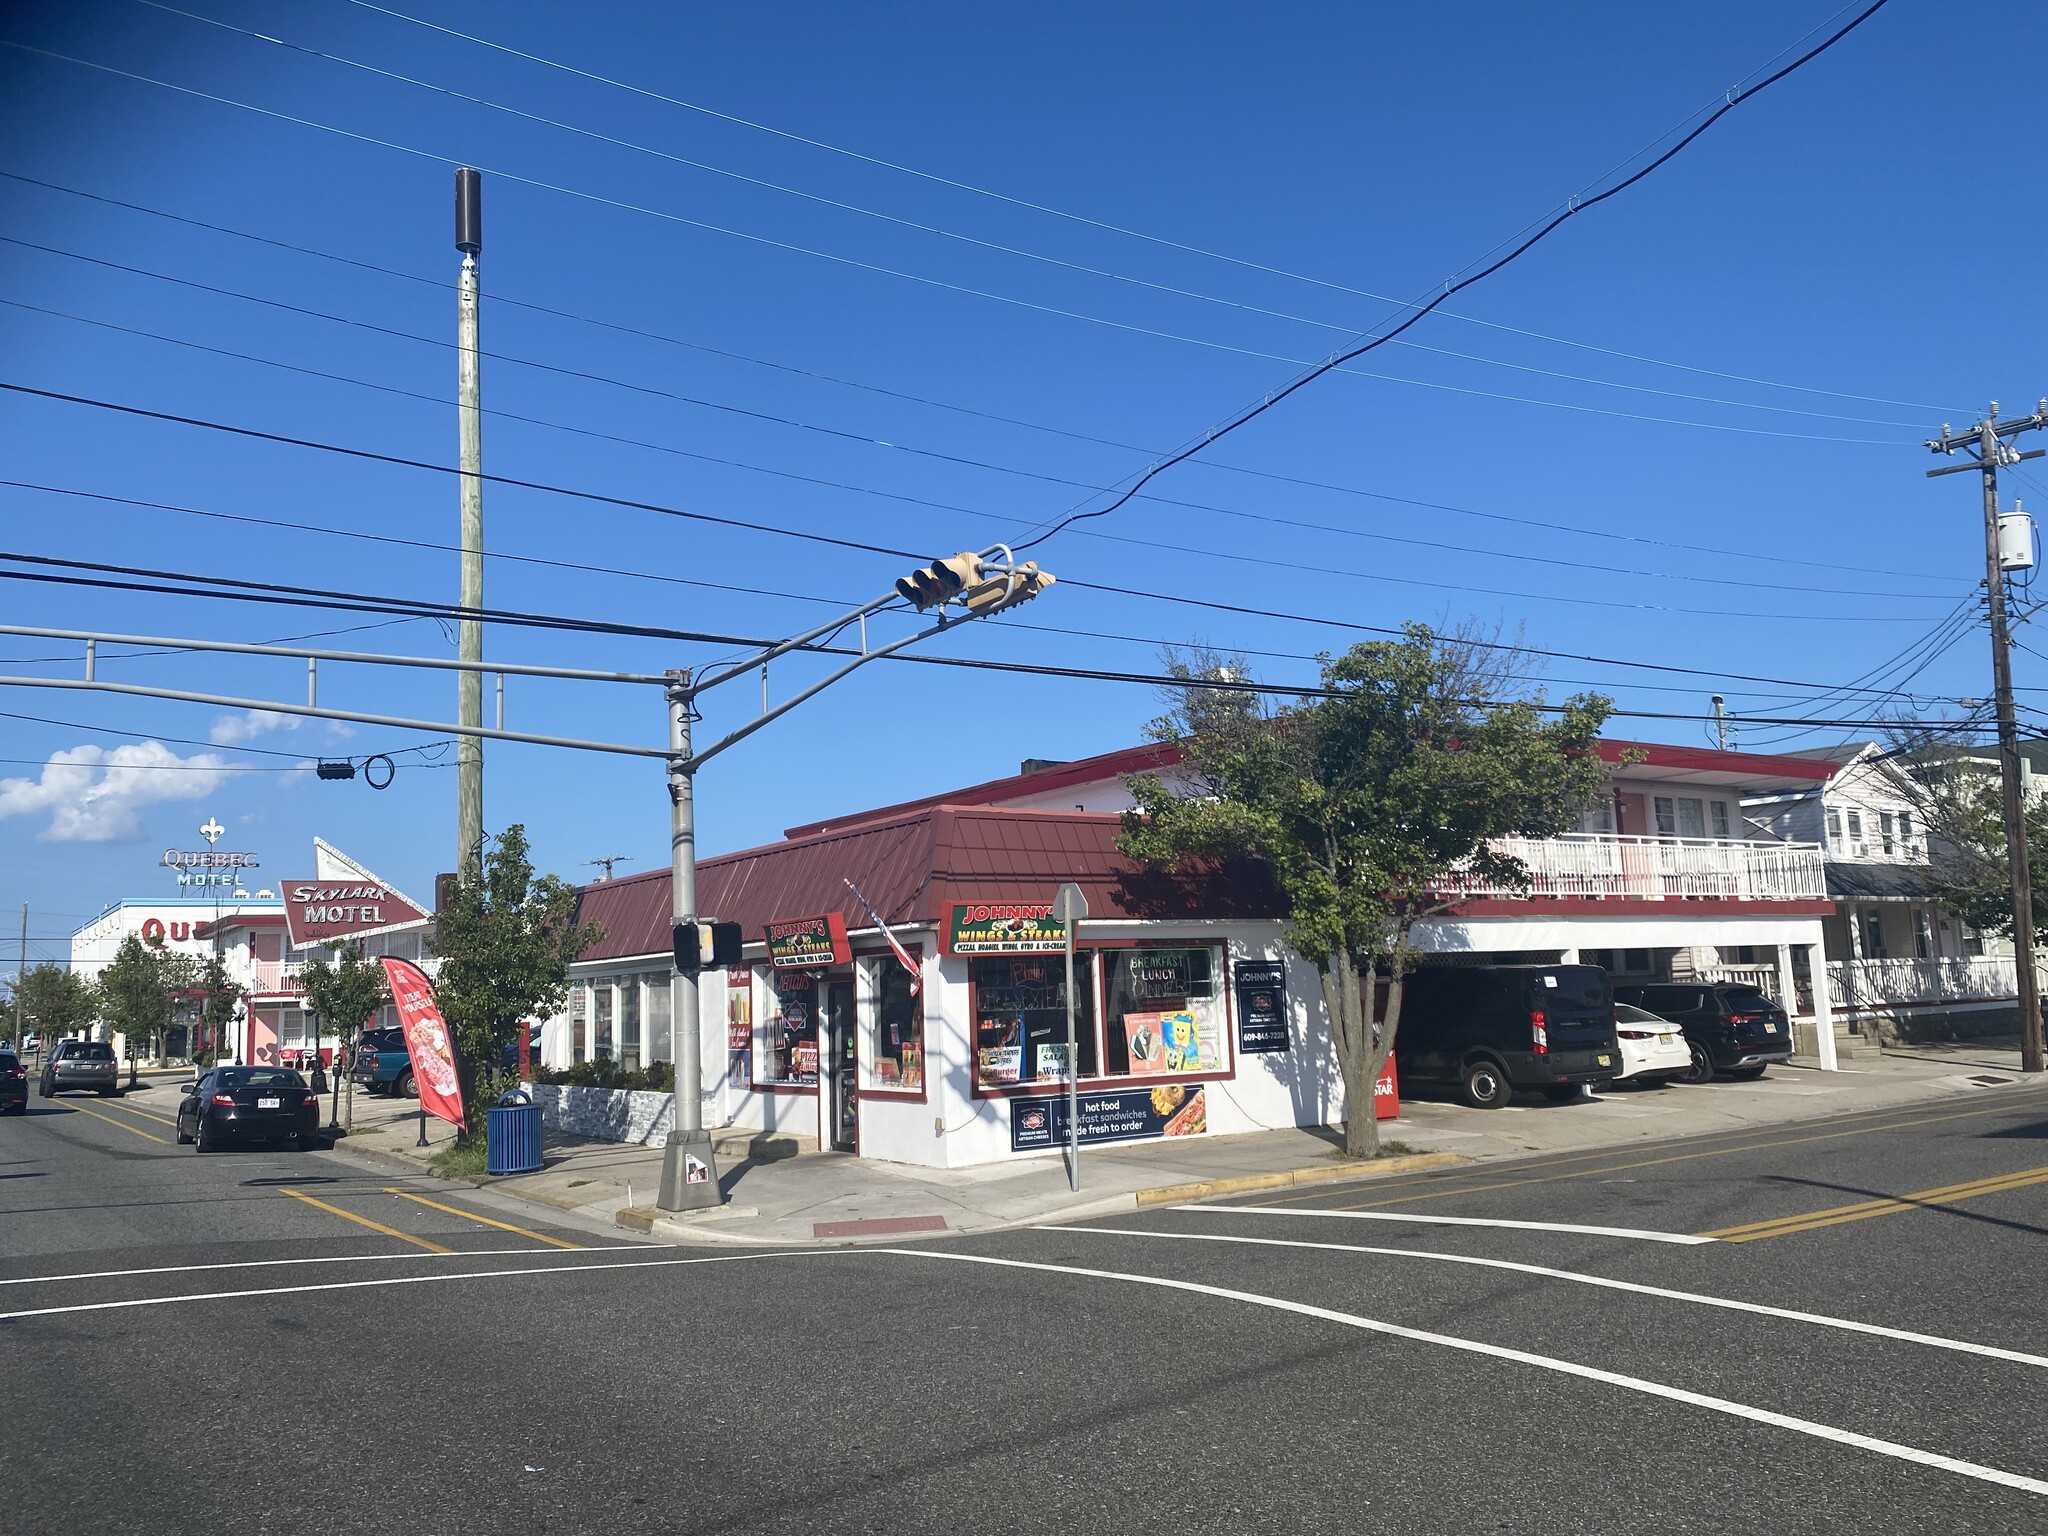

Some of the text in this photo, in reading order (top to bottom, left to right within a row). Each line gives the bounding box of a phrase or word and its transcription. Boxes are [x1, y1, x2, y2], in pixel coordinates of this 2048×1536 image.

[163, 848, 258, 870] QUEBEC
[177, 873, 244, 886] MOTEL
[290, 886, 389, 903] SKYLARK
[304, 905, 386, 923] MOTEL
[770, 920, 825, 942] JOHNNY'S
[958, 931, 1003, 941] WINGS
[1007, 930, 1016, 941] &
[772, 946, 795, 956] WINGS
[804, 942, 830, 953] STEAKS
[1131, 957, 1184, 968] BREAKFAST
[1141, 969, 1176, 980] LUNCH
[1240, 972, 1282, 982] JOHNNY'S
[1133, 980, 1187, 996] DINNER
[403, 991, 421, 1002] TREAT
[1085, 1100, 1120, 1112] hot food
[1057, 1110, 1147, 1126] brekfast sandwiches
[1062, 1121, 1143, 1136] mde fresh to order
